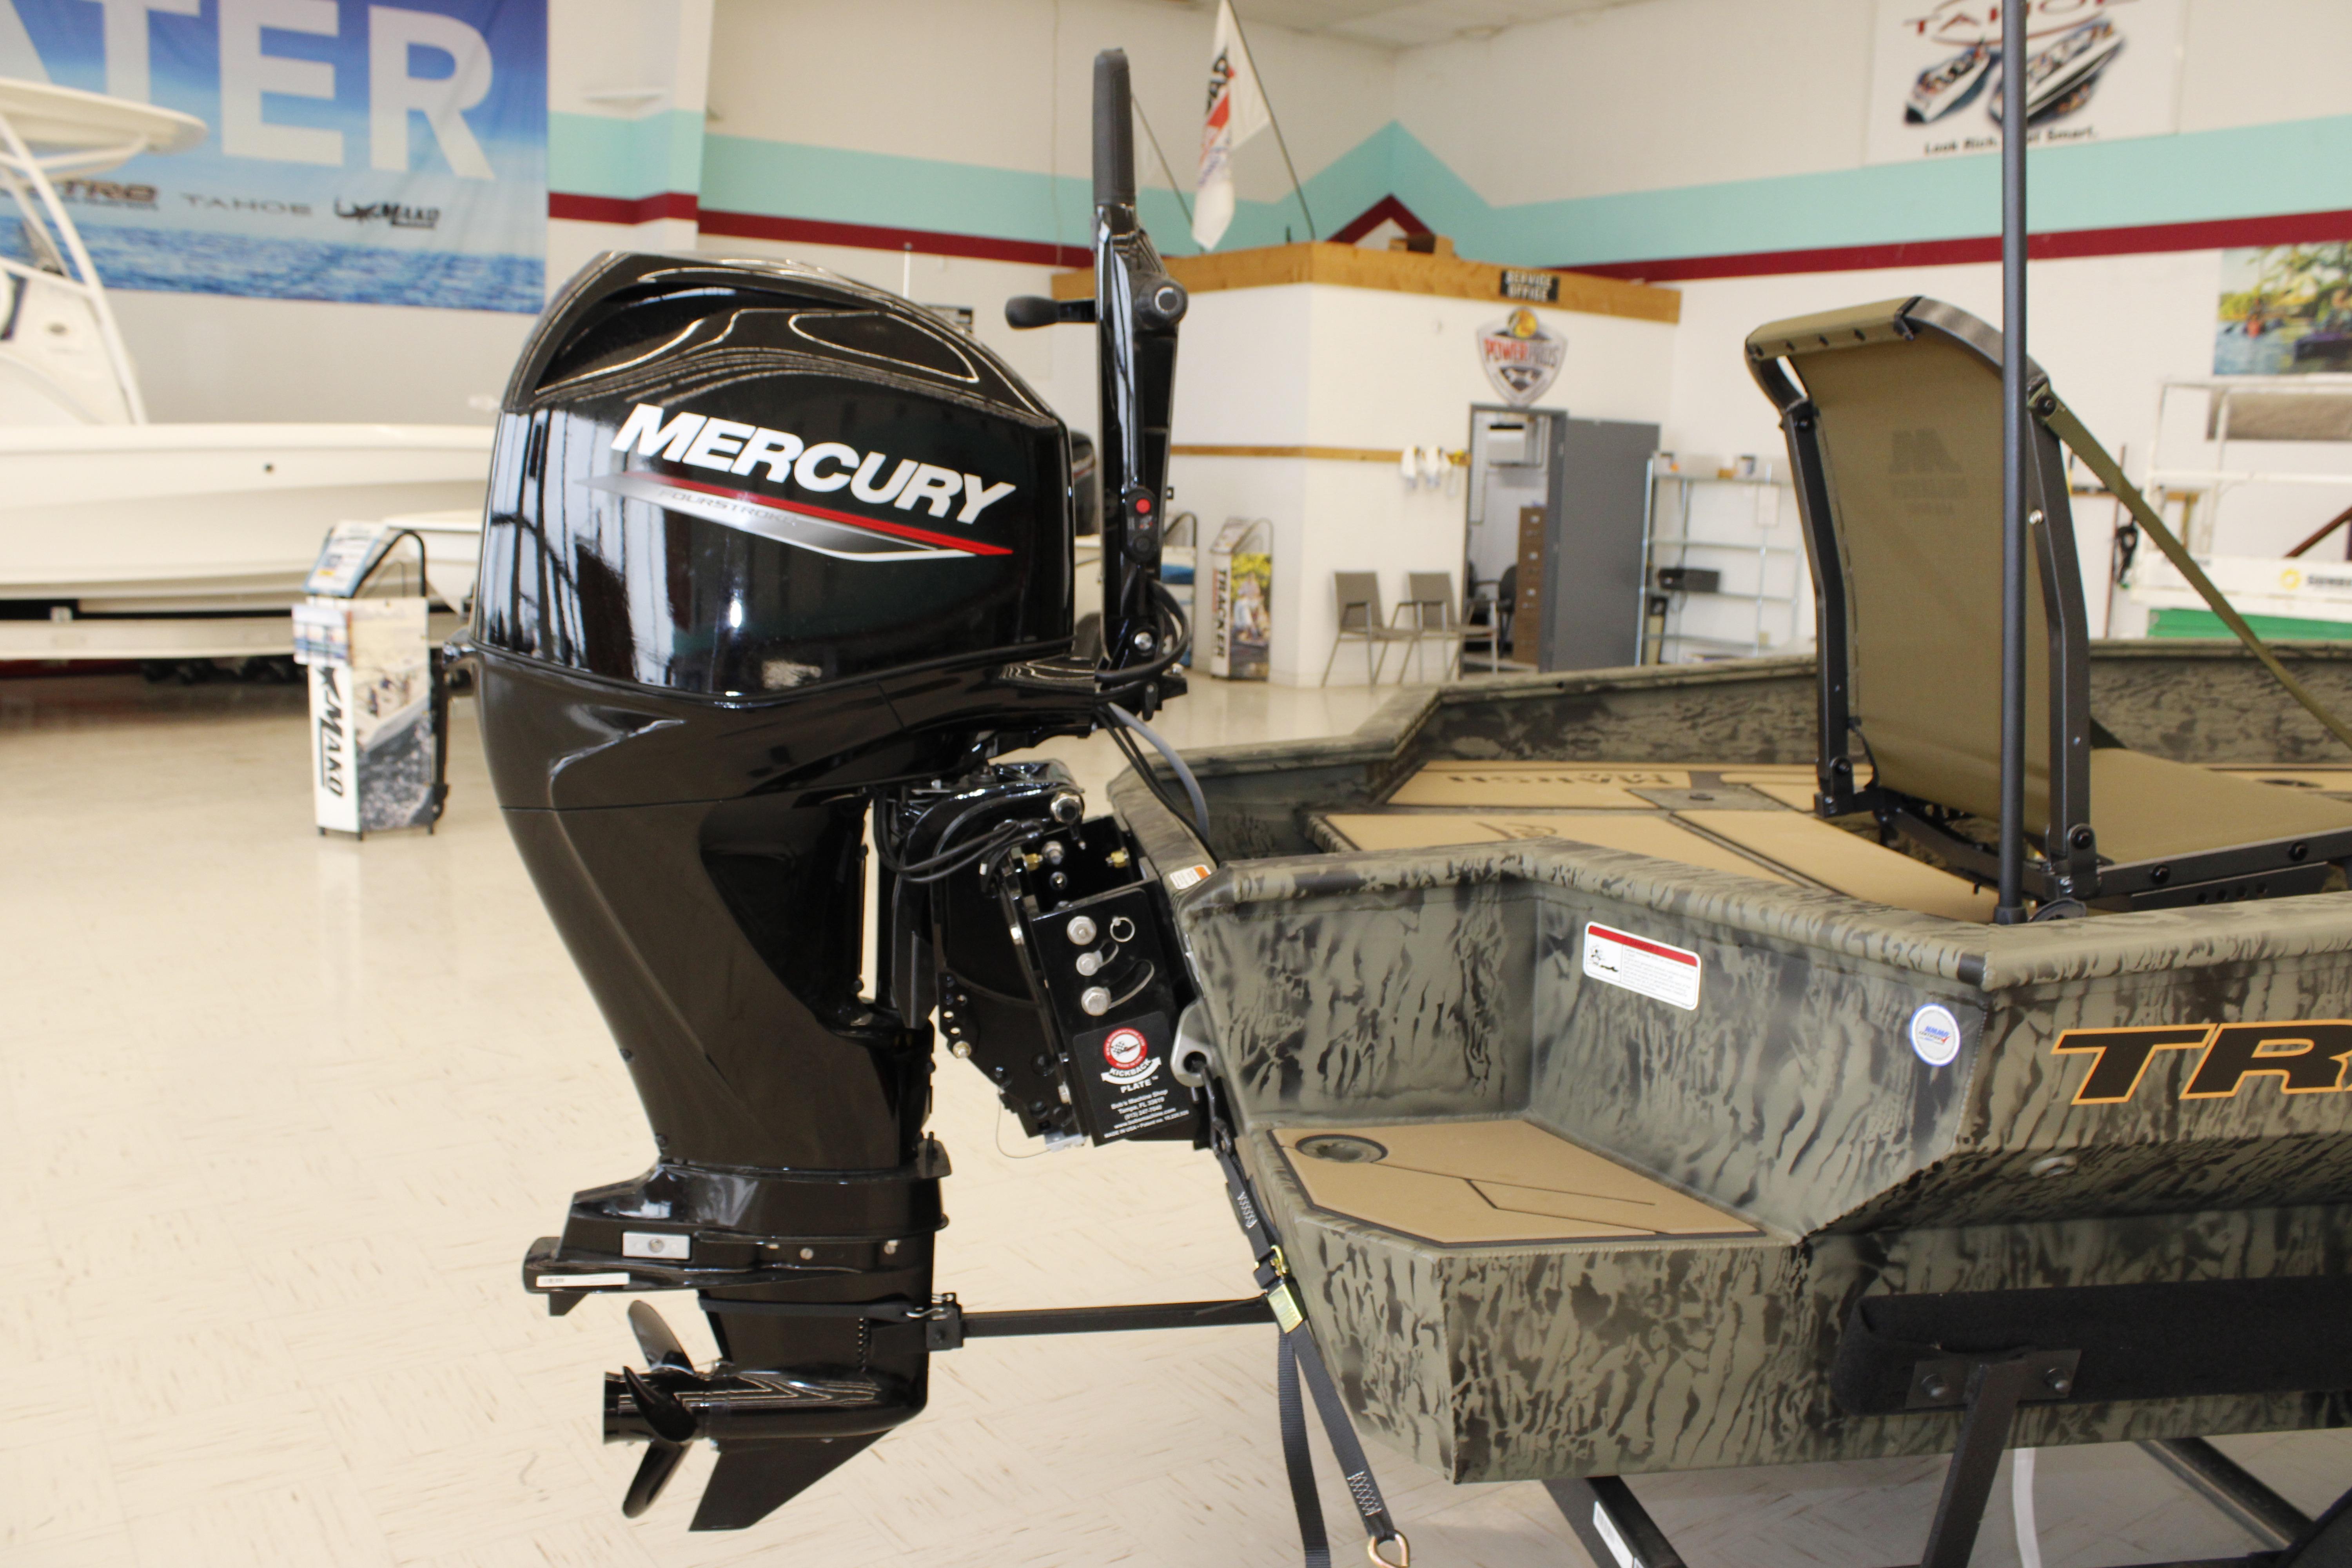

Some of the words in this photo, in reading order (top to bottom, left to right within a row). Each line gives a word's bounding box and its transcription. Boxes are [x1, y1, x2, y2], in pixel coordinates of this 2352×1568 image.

[181, 193, 312, 216] TAHOE
[1505, 270, 1552, 287] SERVICE
[1506, 285, 1548, 301] OFFICE
[610, 403, 1016, 524] MERCURY
[659, 488, 797, 525] FOURSTROKE
[1217, 570, 1227, 658] TRACKER
[318, 702, 345, 797] MAKO
[1109, 1058, 1152, 1077] KICKBACK
[2051, 1019, 2352, 1105] TR
[1111, 1101, 1128, 1110] Bob's
[1128, 1094, 1152, 1105] Machine
[1152, 1089, 1169, 1098] Shop
[1118, 1105, 1139, 1114] Tampa,
[1104, 1130, 1120, 1139] MADE
